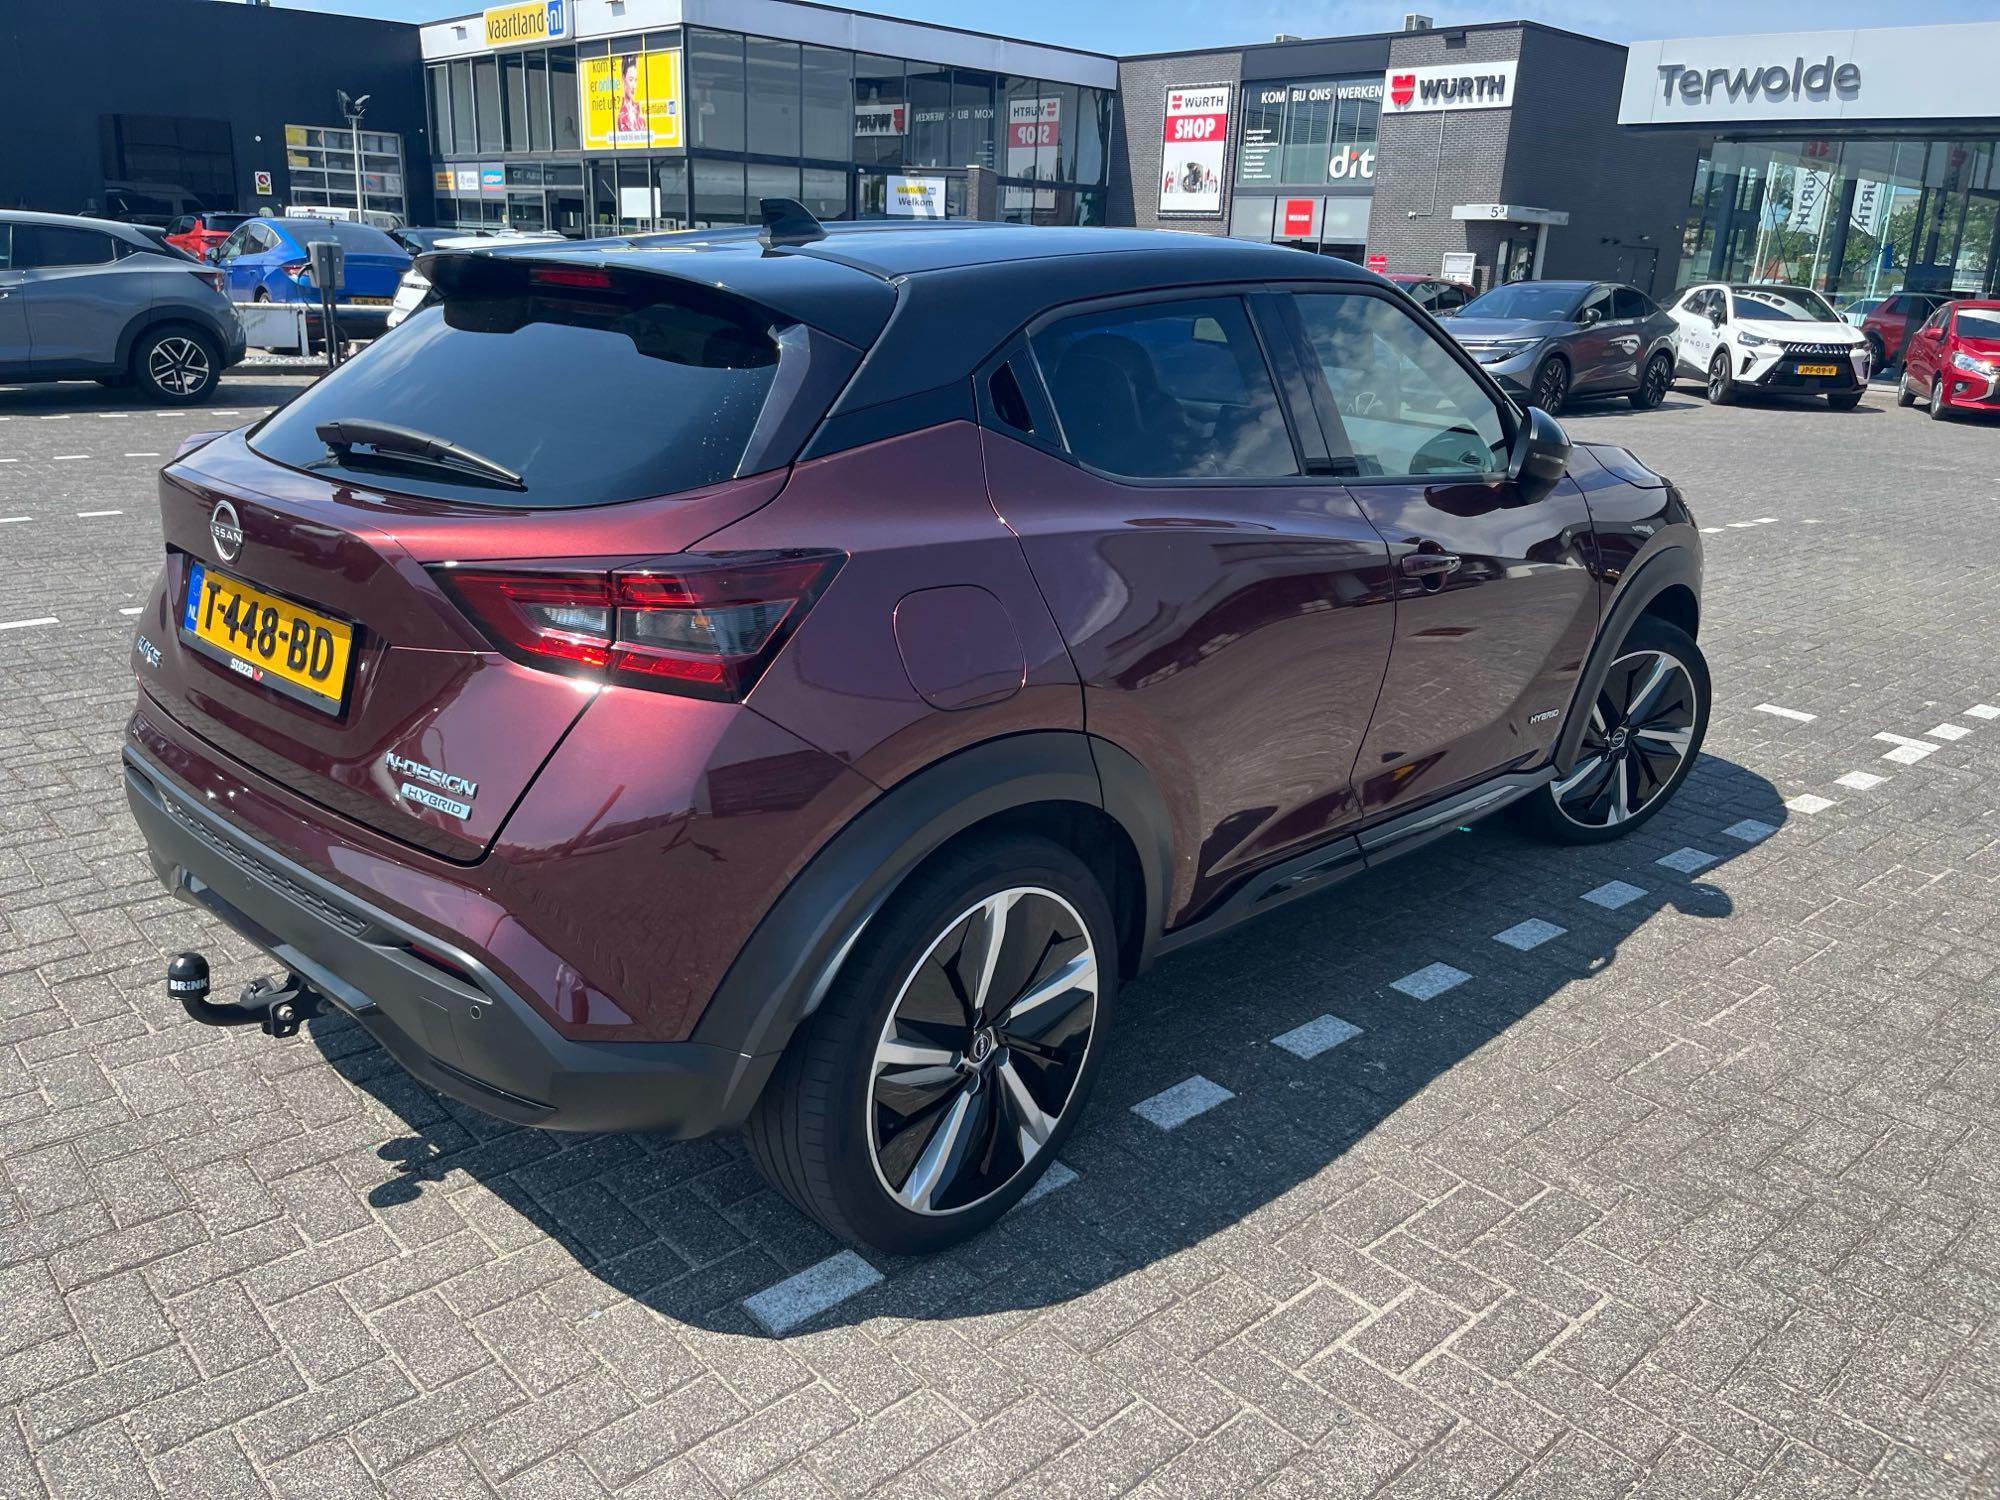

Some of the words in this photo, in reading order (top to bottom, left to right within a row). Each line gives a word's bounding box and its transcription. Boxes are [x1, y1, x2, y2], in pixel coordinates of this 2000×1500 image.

[1419, 75, 1505, 99] WÜRTH
[1657, 55, 1861, 99] Terwolde
[592, 98, 606, 111] niet
[1185, 95, 1224, 108] WÜRTH
[1261, 91, 1286, 104] KOM
[1309, 88, 1331, 101] ONS
[1337, 85, 1384, 100] WERKEN
[1174, 117, 1216, 139] SHOP
[1329, 145, 1375, 179] dit
[898, 197, 934, 207] Welkom
[188, 604, 197, 621] NL
[205, 580, 334, 681] T-448-BD
[1530, 709, 1560, 725] HYBRID
[386, 752, 478, 800] N-DESIGN
[408, 786, 462, 815] HYBRID
